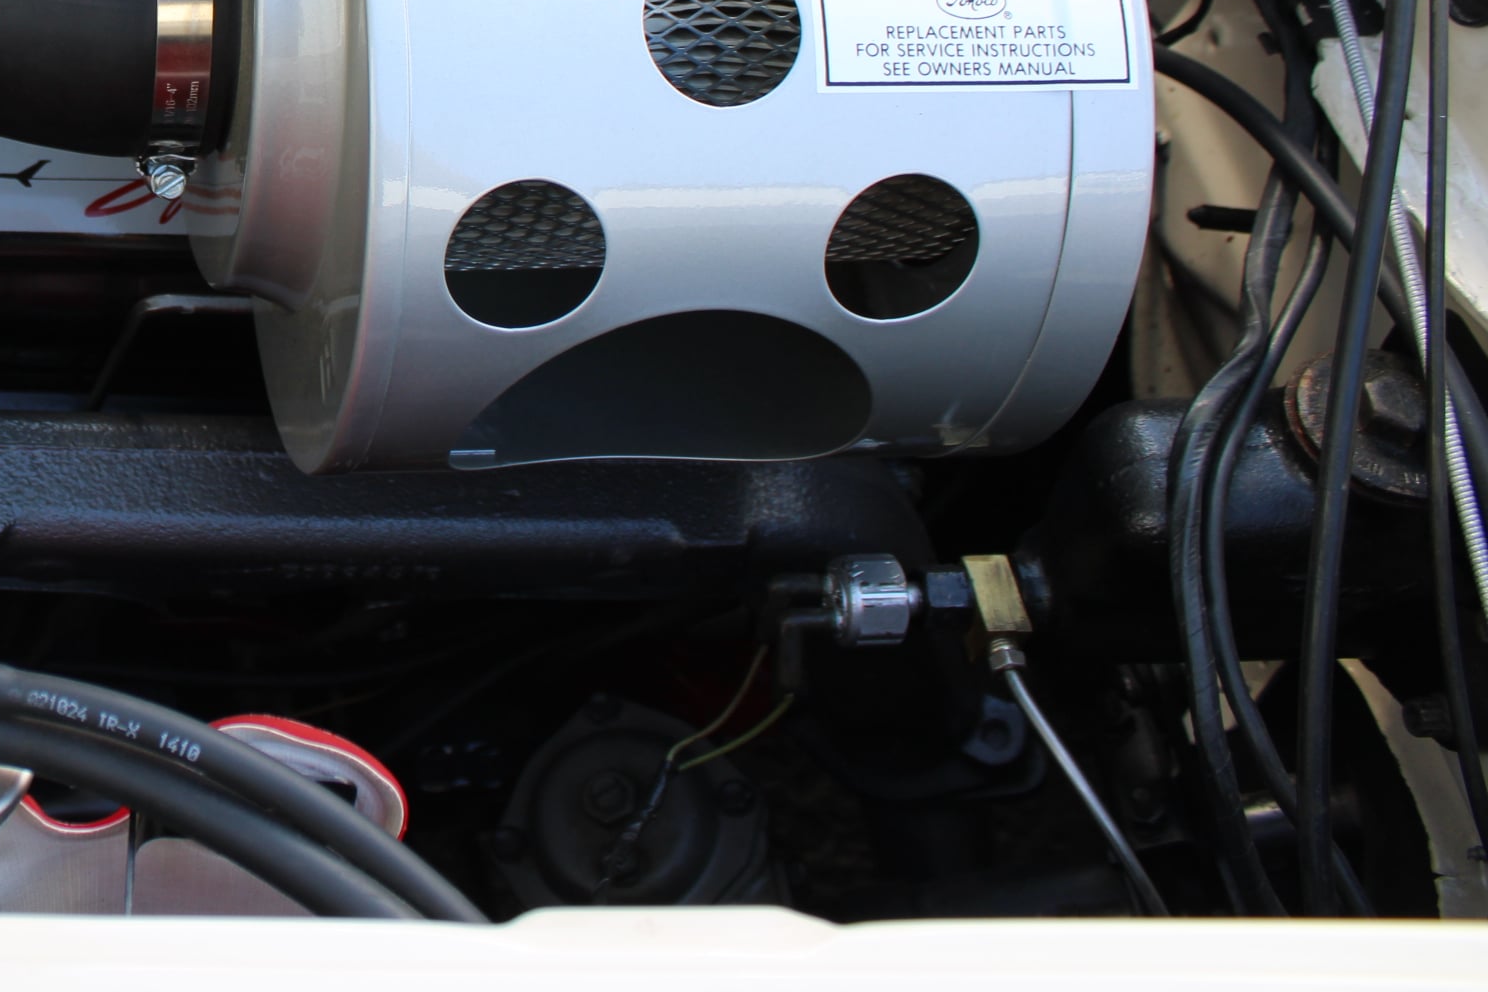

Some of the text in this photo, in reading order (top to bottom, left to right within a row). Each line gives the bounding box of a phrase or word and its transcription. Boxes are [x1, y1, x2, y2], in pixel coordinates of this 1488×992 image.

[886, 25, 1066, 39] REPLACEMENT PARTS
[856, 43, 1096, 57] FOR SERVICE INSTRUCTIONS
[883, 62, 1076, 76] SEE OWNERS MANUAL
